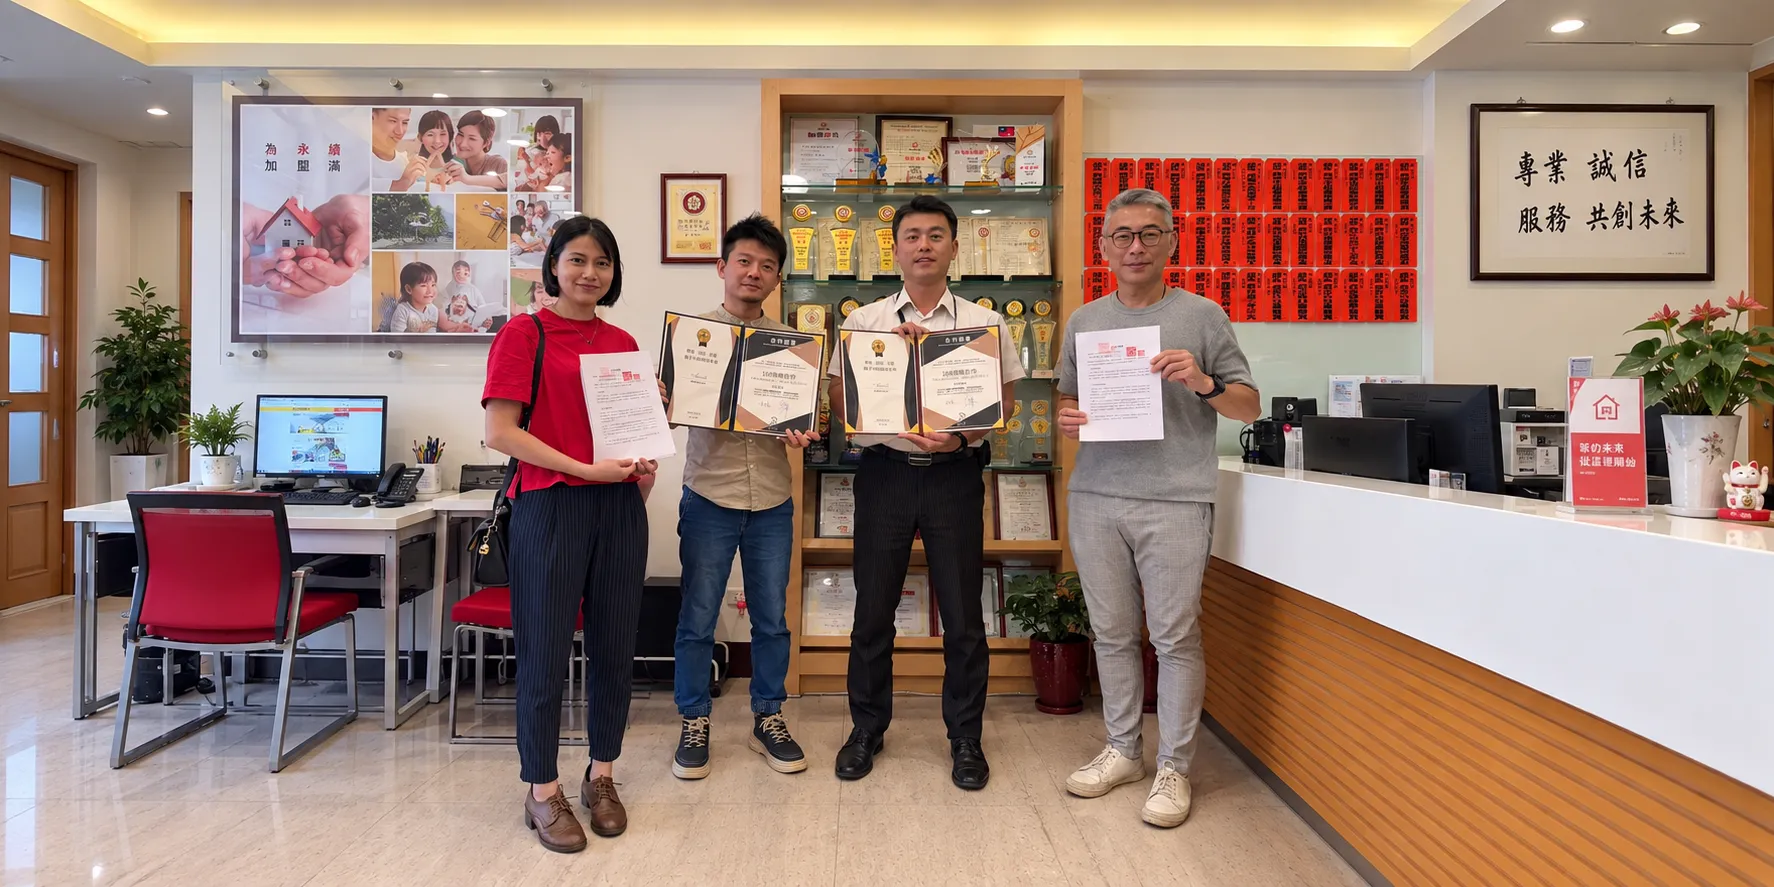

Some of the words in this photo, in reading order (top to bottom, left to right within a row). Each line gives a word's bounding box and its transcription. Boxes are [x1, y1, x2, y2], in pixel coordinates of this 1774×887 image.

[1514, 149, 1568, 187] 專業
[1587, 149, 1648, 183] 誠信
[1518, 202, 1571, 233] 服務
[1586, 197, 1685, 231] 共創未來
